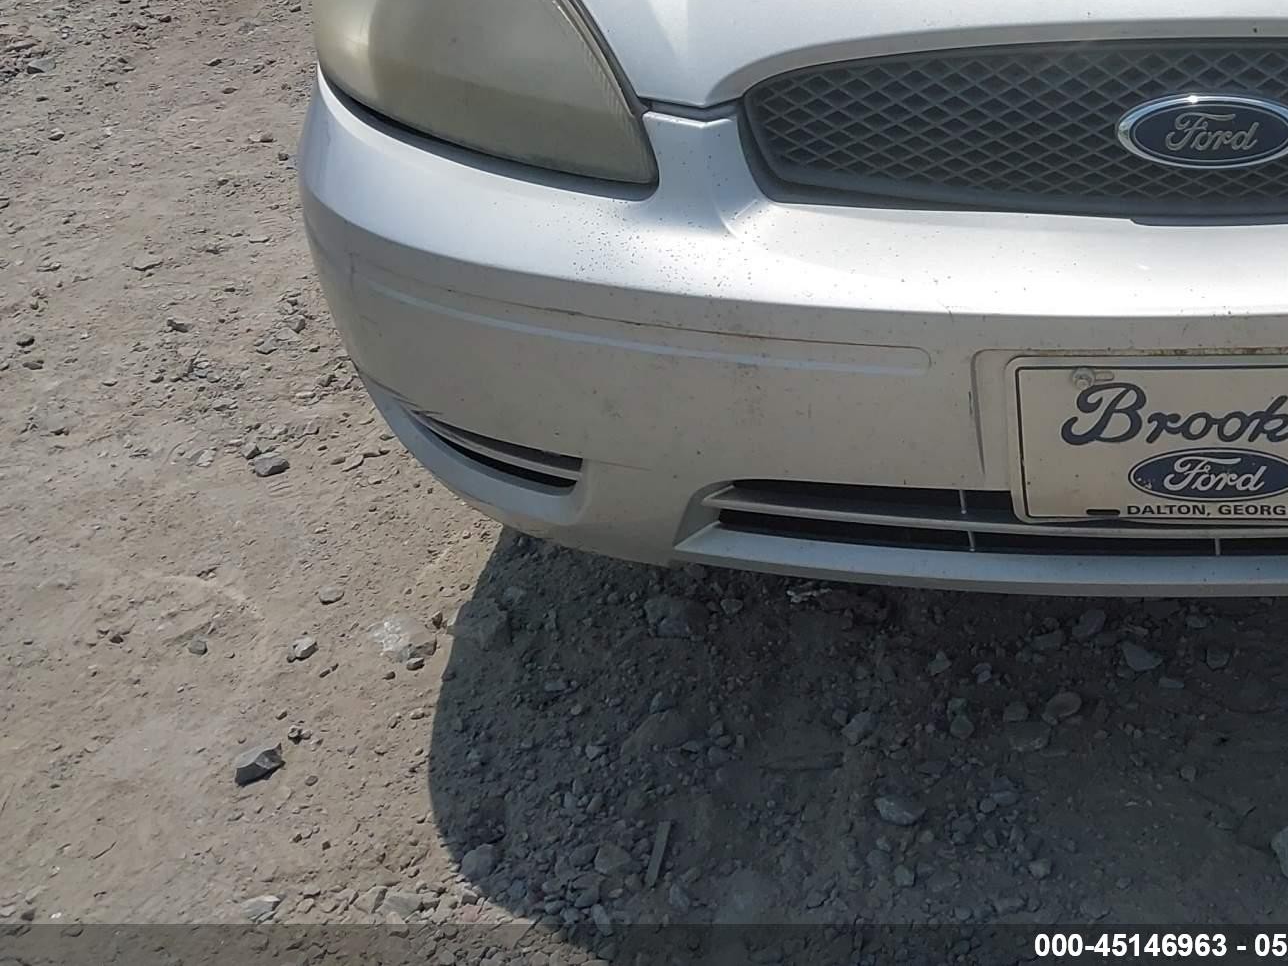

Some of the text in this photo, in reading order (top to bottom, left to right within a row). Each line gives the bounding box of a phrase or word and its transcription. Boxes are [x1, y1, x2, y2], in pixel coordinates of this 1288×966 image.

[1165, 112, 1260, 151] Ford
[1163, 455, 1268, 493] Ford
[1126, 504, 1212, 517] DALTON,
